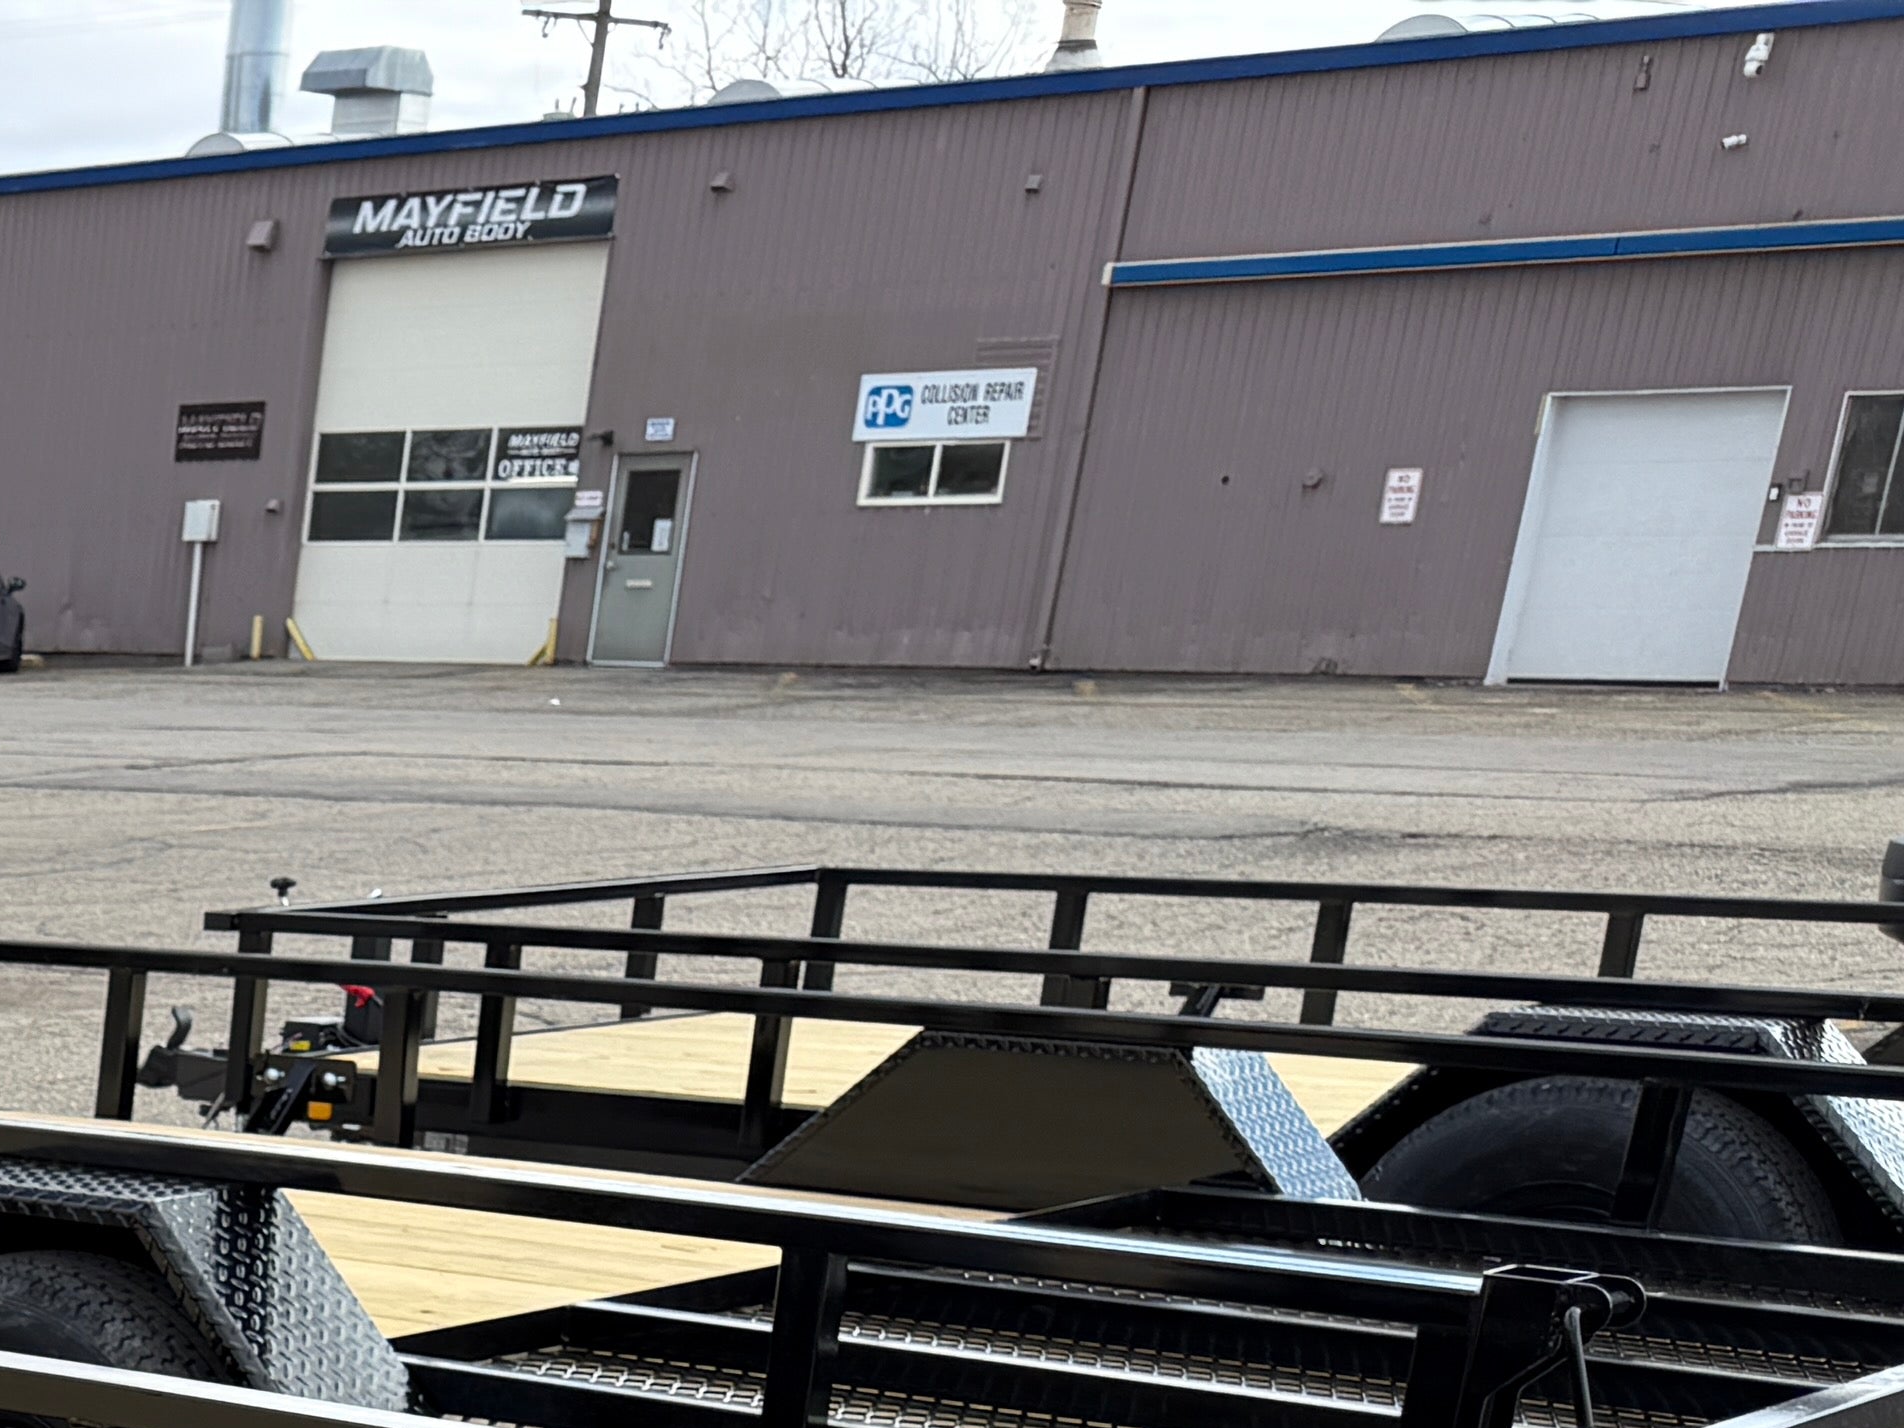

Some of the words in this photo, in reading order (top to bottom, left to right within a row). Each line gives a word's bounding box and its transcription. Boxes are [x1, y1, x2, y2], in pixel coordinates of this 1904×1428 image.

[352, 183, 587, 234] MAYFIELD
[397, 227, 460, 247] AUTO
[464, 221, 532, 244] BODY
[921, 383, 979, 404] COLLISION
[983, 381, 1025, 401] REPAIR
[866, 388, 912, 425] PPG
[947, 405, 990, 425] CENTER
[498, 458, 566, 477] OFFICE
